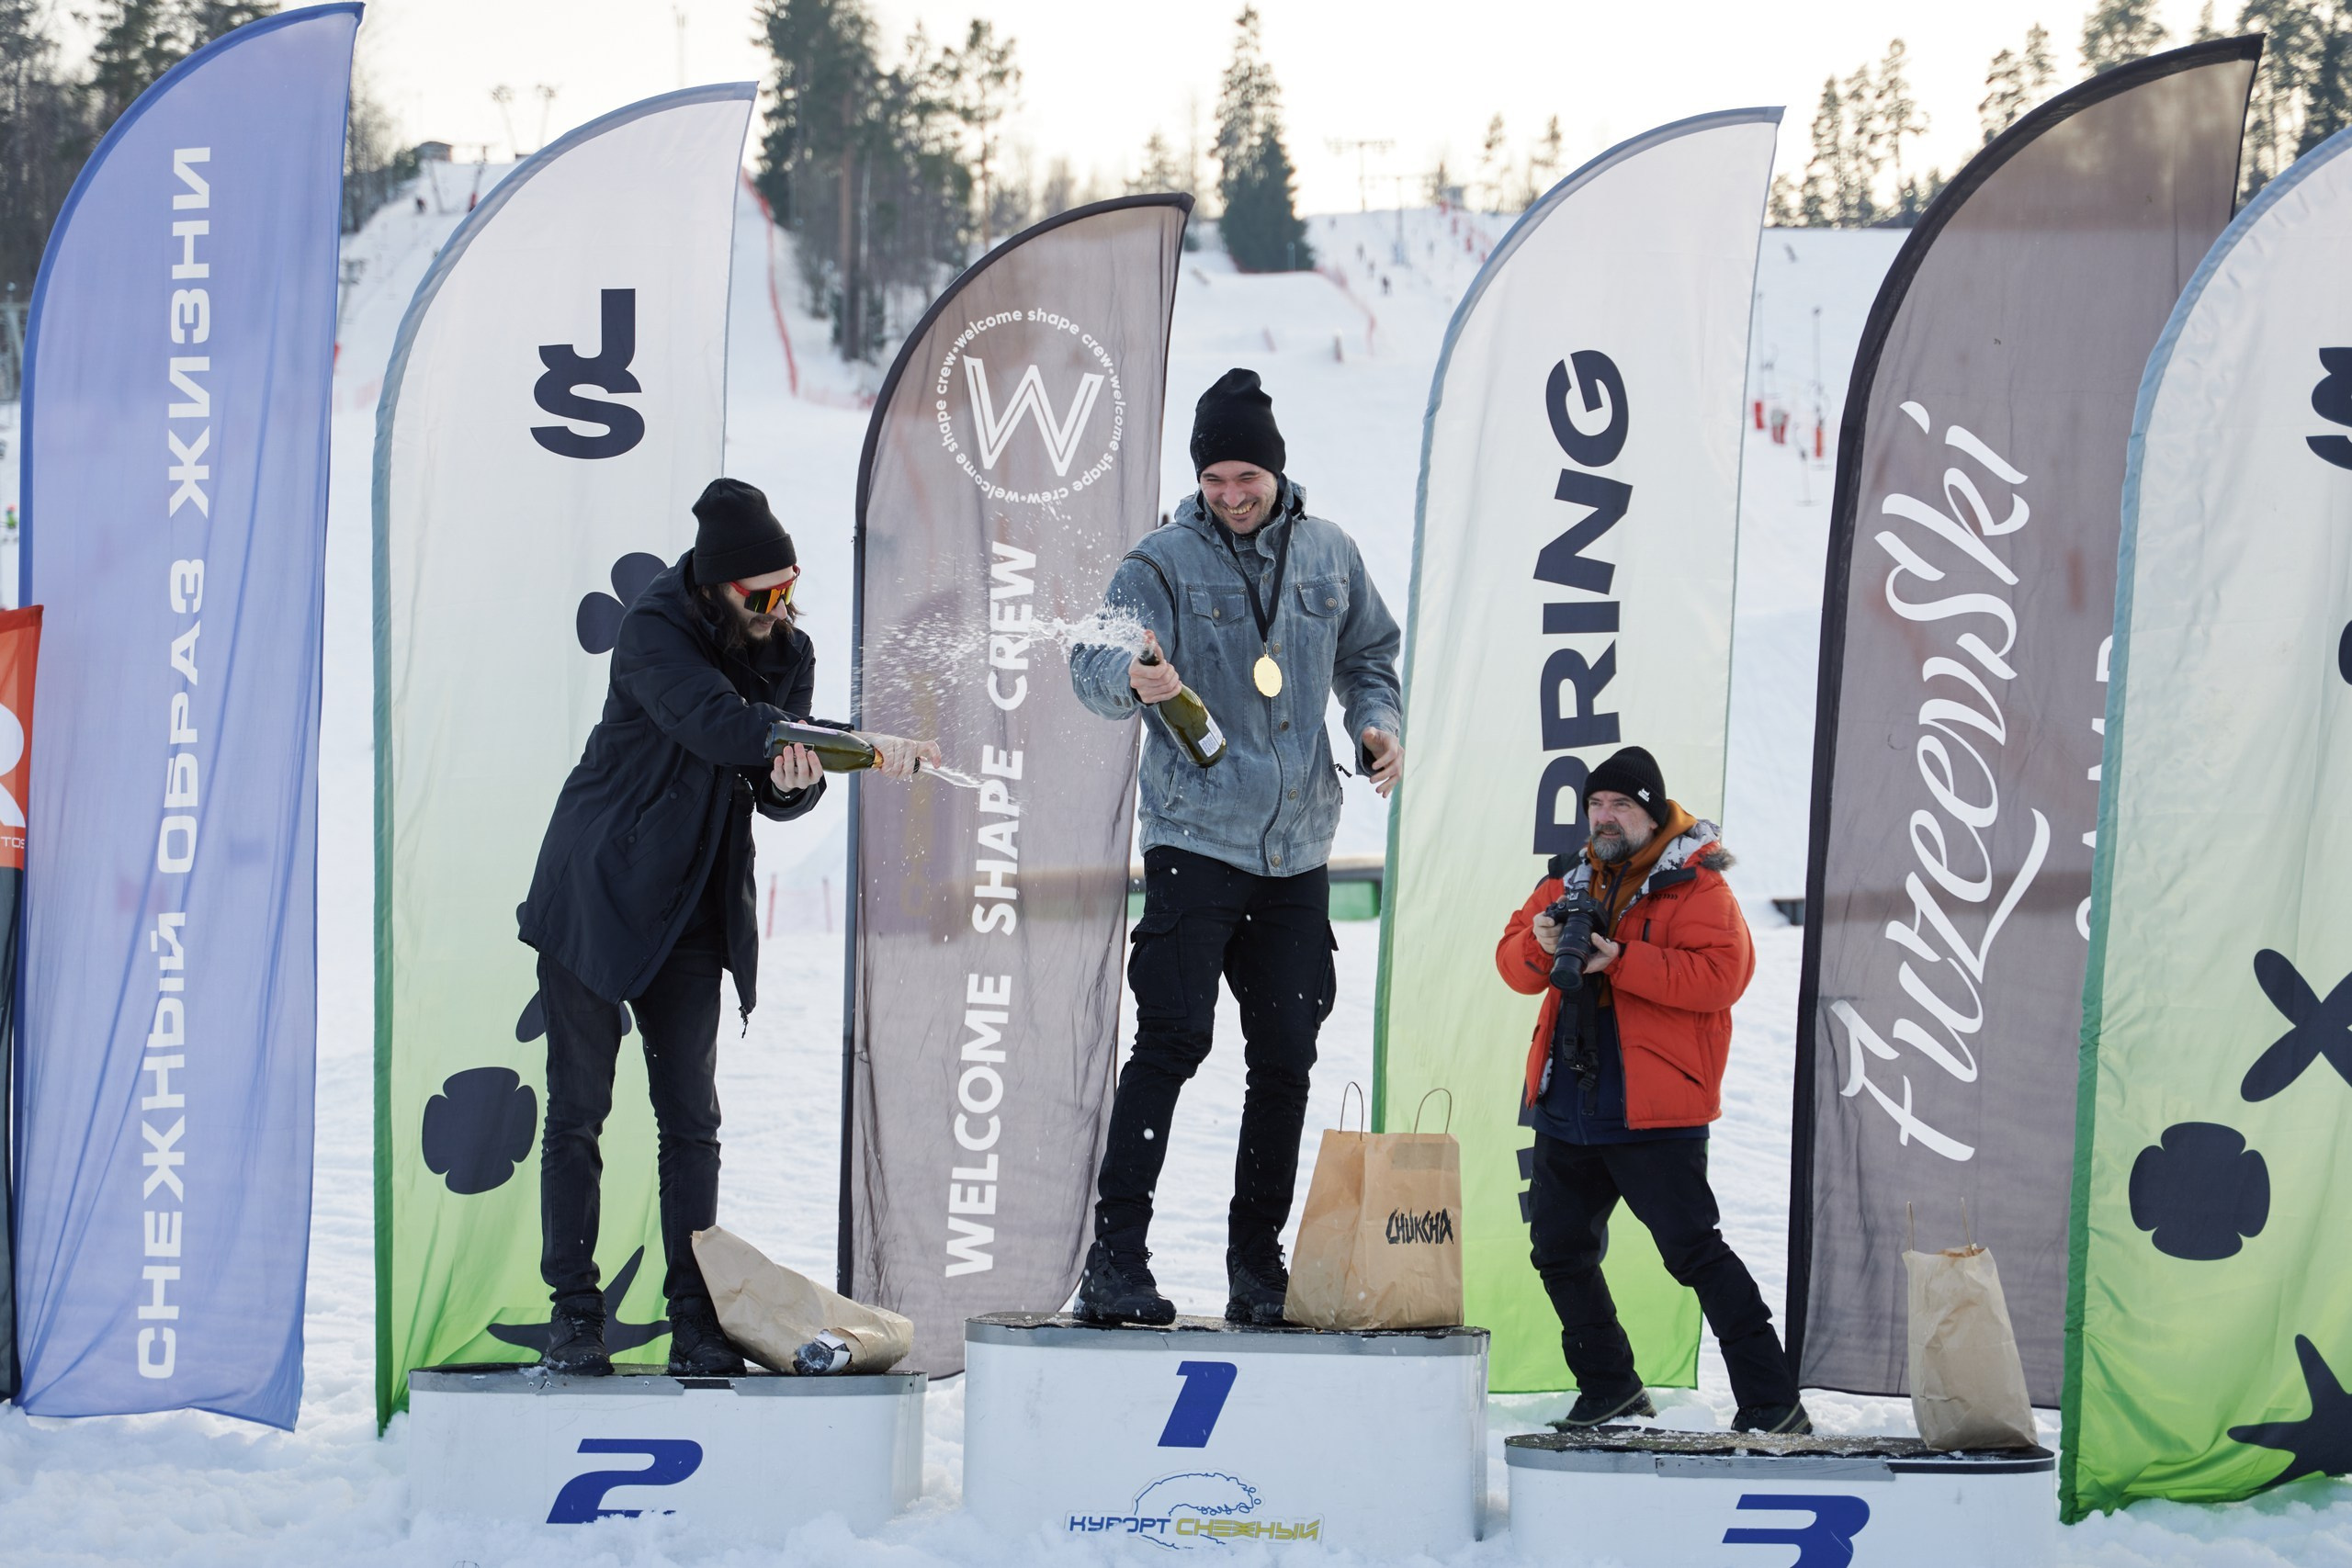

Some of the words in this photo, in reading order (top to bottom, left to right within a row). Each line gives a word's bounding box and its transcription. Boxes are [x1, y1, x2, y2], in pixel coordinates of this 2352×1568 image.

[168, 146, 211, 520] ЖИЗНИ
[988, 541, 1036, 711] CREW
[1533, 349, 1634, 896] PRING
[157, 557, 205, 874] ОБРАЗ
[972, 744, 1023, 936] SHAPE
[138, 912, 187, 1380] СНЕЖНЫЙ
[945, 973, 1012, 1278] WELCOME
[1385, 1207, 1453, 1245] CHUKCHA
[546, 1438, 703, 1524] 2
[1158, 1361, 1238, 1448] 1
[1069, 1516, 1171, 1534] КУРОРТ
[1175, 1517, 1320, 1540] СНЕЖНЫЙ
[1723, 1495, 1871, 1568] 3
